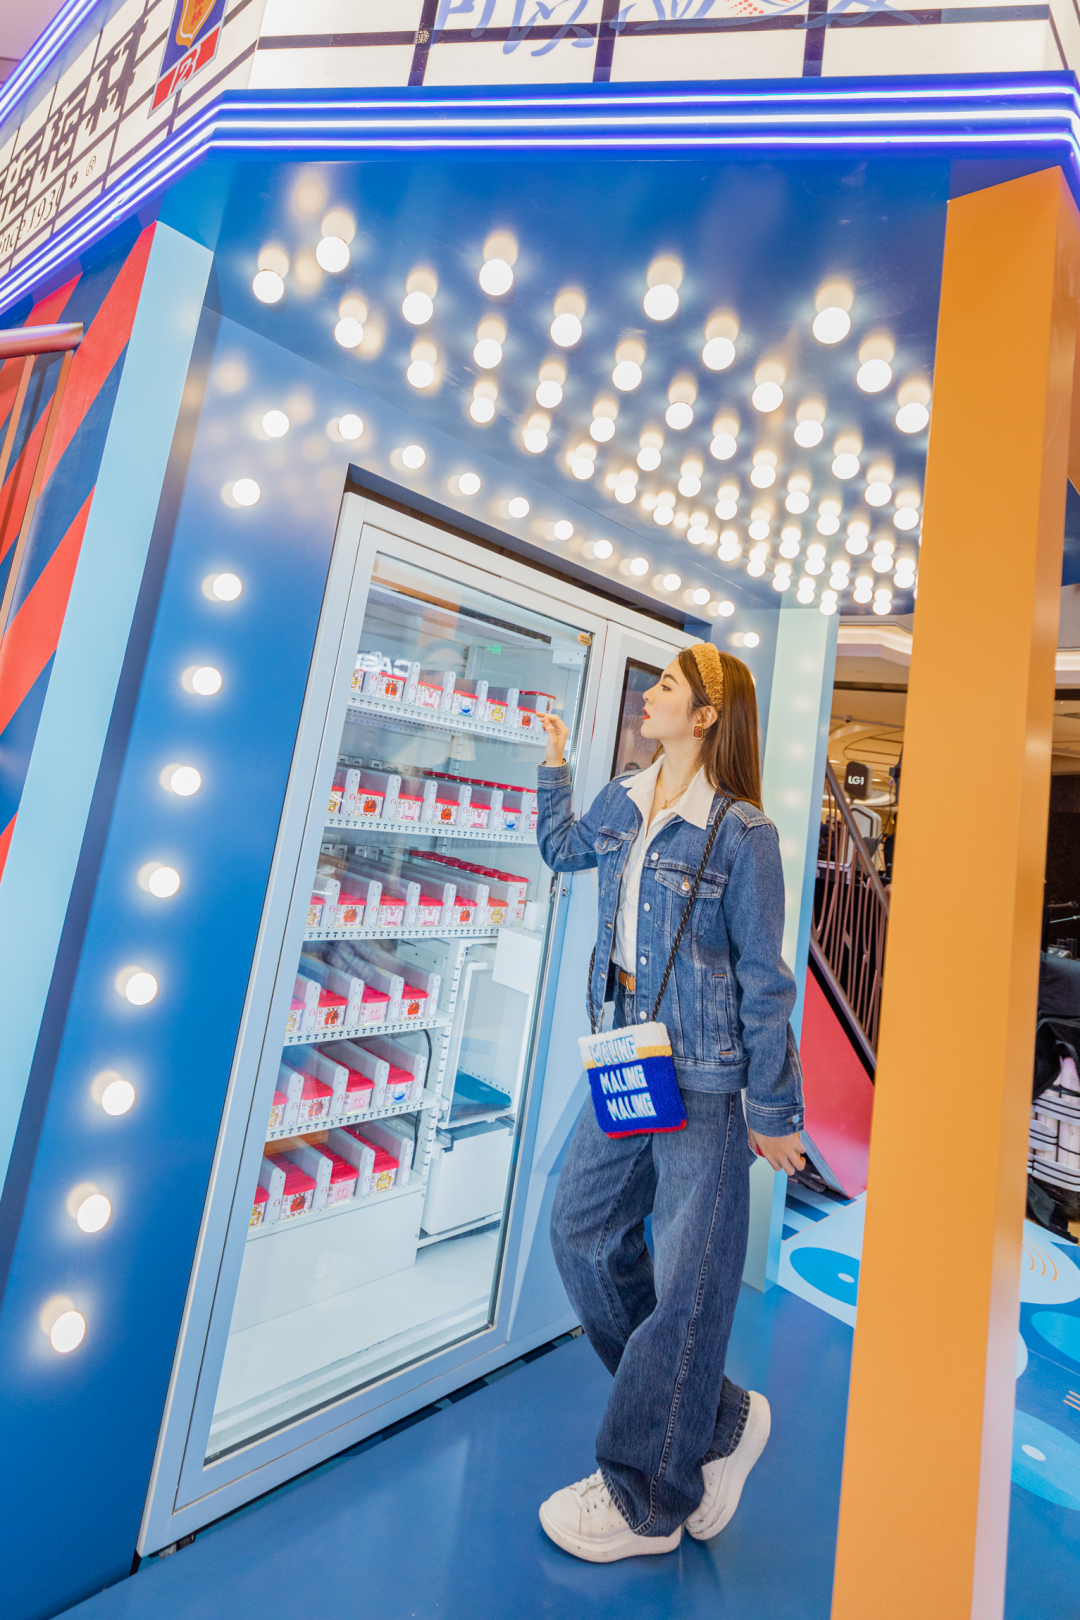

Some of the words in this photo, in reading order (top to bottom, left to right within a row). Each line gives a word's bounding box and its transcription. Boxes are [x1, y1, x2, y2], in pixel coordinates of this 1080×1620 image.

[0, 16, 148, 222] 海梅林
[0, 219, 26, 255] ince
[27, 181, 66, 232] 1930
[848, 775, 864, 785] LG1
[589, 1035, 639, 1067] MALING
[599, 1064, 648, 1094] MALING
[606, 1092, 657, 1121] MALING
